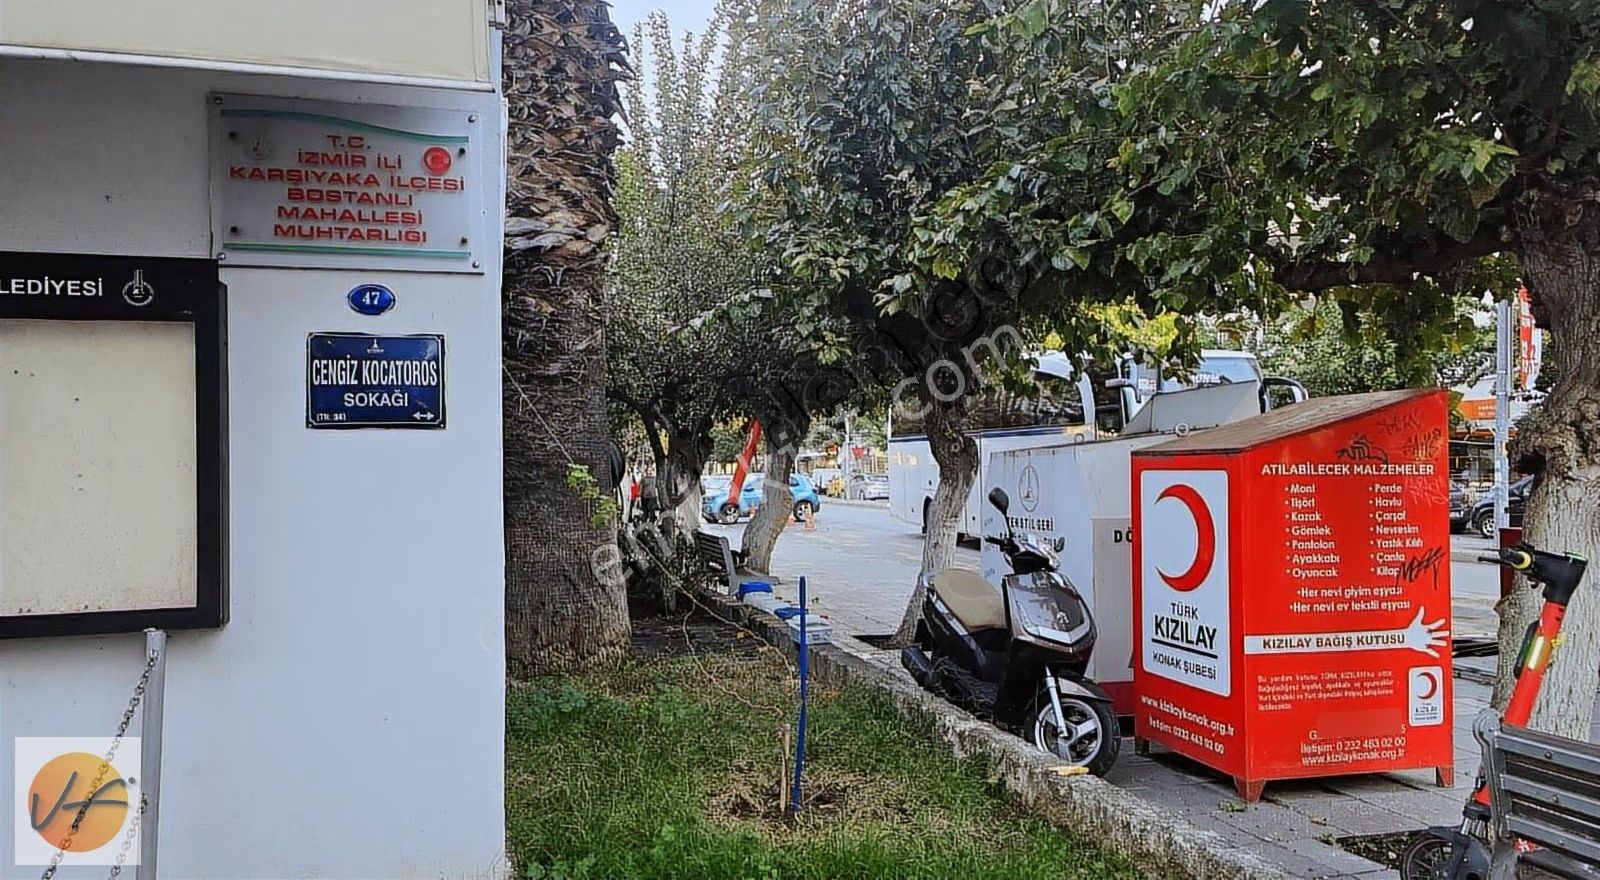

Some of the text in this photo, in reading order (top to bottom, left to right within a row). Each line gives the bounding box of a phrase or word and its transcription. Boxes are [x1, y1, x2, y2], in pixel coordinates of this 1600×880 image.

[327, 135, 371, 149] T.C.
[298, 148, 402, 169] İZMİR İLİ
[230, 166, 465, 194] KARŞIYAKA İLÇESİ
[288, 188, 413, 206] BOSTANLI
[277, 205, 423, 225] MAHALLESİ
[274, 223, 427, 243] MUHTARLIĞI
[0, 276, 102, 296] LEDİYESİ
[362, 291, 380, 305] 47
[312, 354, 437, 385] CENGİZ KOCATOROS
[344, 389, 408, 407] SOKAĞI
[1261, 462, 1434, 475] ATILABİLECEK MALZEMELER
[1290, 484, 1315, 493] Mont
[1374, 484, 1402, 493] Perde
[1375, 498, 1402, 507] Havlu
[1291, 512, 1321, 521] Kazak
[1291, 525, 1331, 535] Gömlek
[1376, 524, 1419, 534] Nevresim
[1292, 540, 1335, 549] Pantolon
[1292, 554, 1340, 565] Ayakkabı
[1376, 552, 1405, 563] Çanta
[1292, 568, 1338, 579] Oyuncak
[1321, 587, 1342, 596] nevi
[1344, 587, 1371, 599] giyim
[1171, 601, 1198, 620] TÜRK
[1313, 602, 1334, 611] nevi
[1336, 603, 1350, 611] ev
[1351, 600, 1380, 610] tekstil
[1382, 600, 1410, 612] eşyası
[1155, 614, 1217, 650] KIZILAY
[1263, 634, 1405, 649] KIZILAY BAĞIŞ KUTUSU
[1153, 651, 1217, 680] KONAK ŞUBESİ
[1336, 741, 1343, 751] 0
[1344, 740, 1361, 751] 232
[1381, 738, 1392, 748] 02
[1394, 737, 1406, 747] 00
